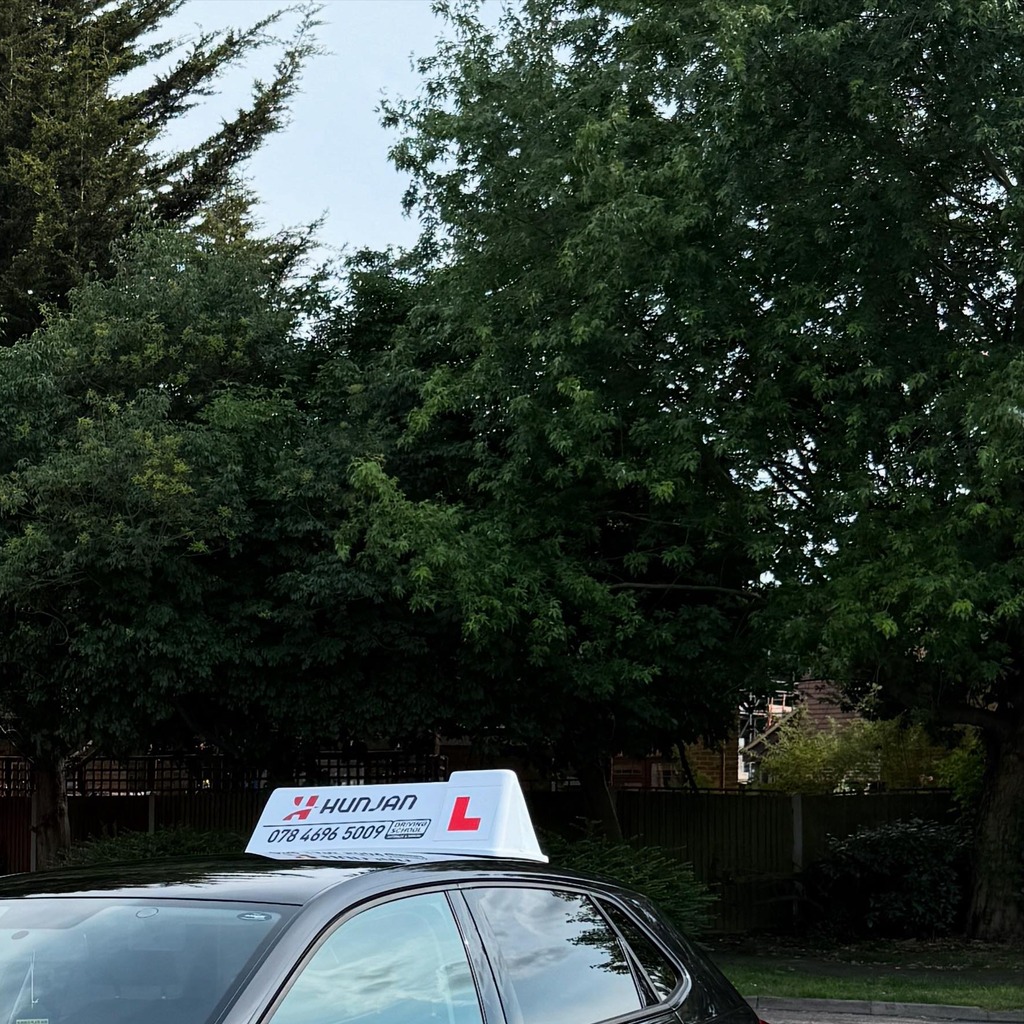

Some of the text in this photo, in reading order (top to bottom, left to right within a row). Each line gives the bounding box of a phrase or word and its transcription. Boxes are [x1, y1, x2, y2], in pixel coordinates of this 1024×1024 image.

[319, 794, 418, 814] HUNJAN
[447, 796, 481, 831] L
[267, 825, 386, 843] 078 4696 5009
